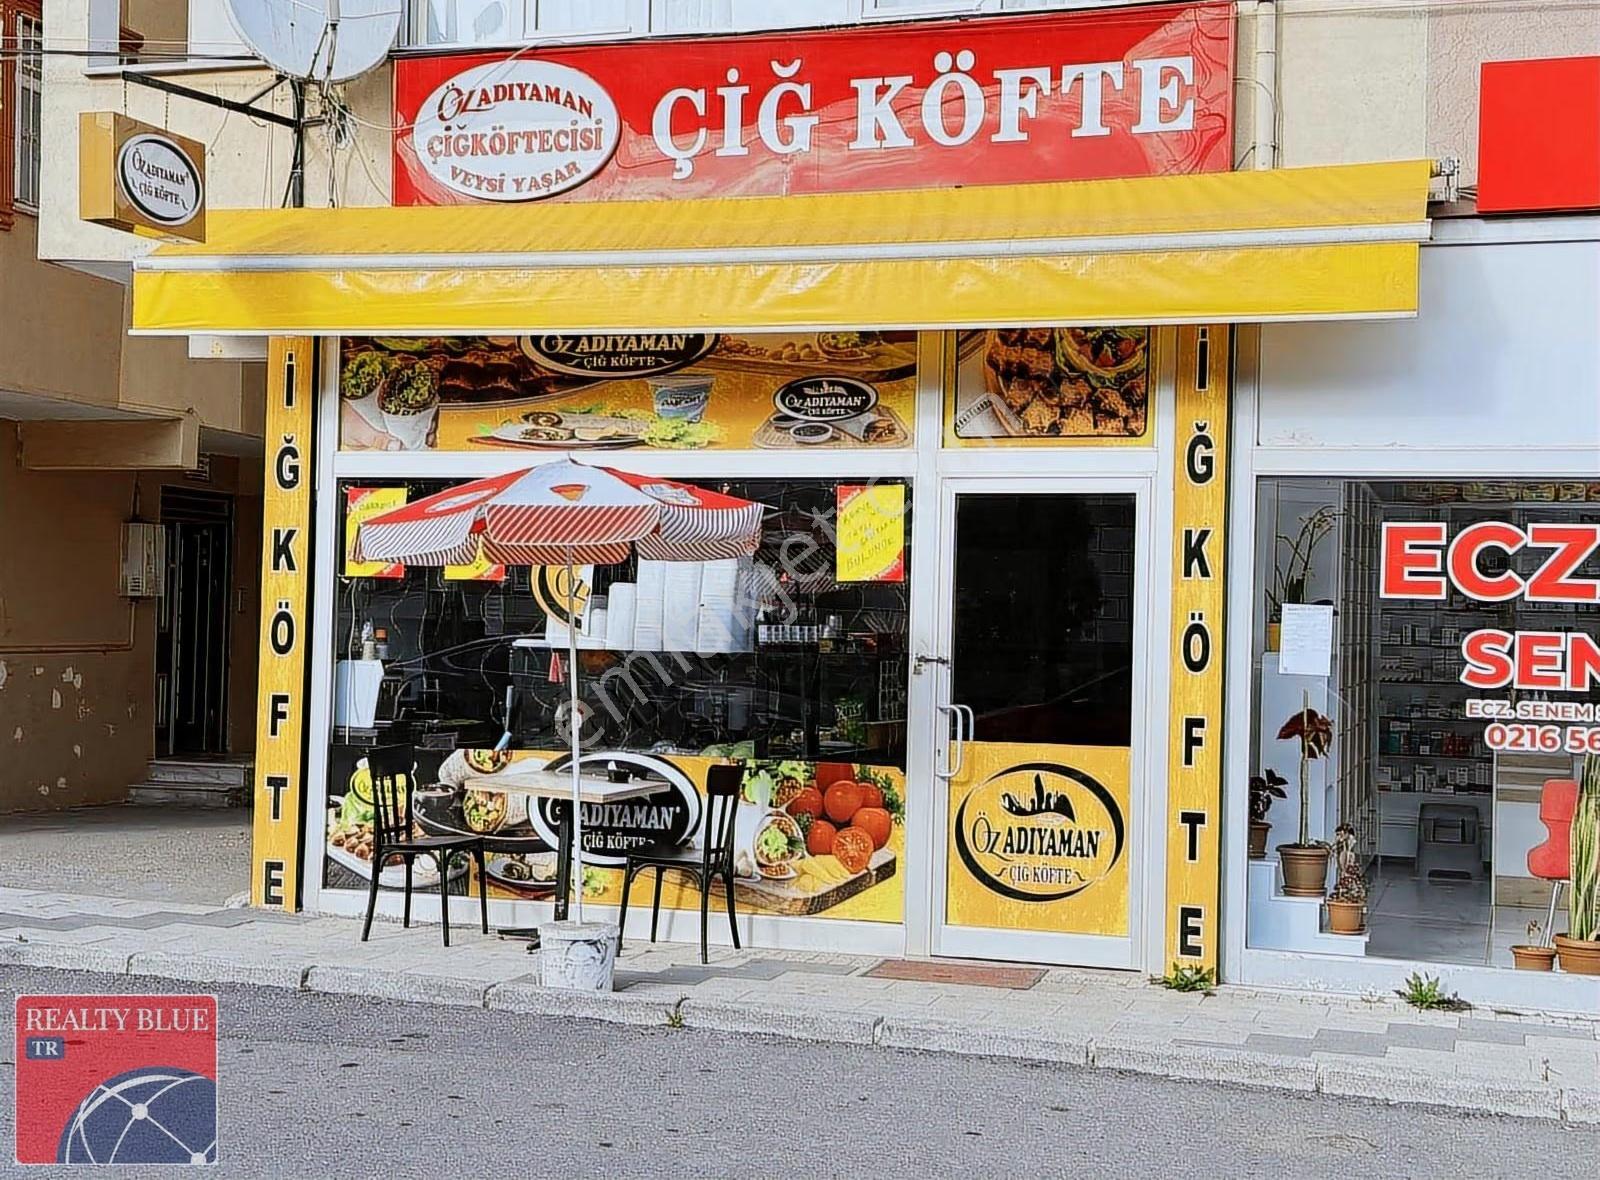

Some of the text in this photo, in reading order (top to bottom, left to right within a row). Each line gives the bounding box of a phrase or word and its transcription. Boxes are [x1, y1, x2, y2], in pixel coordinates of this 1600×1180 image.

[651, 49, 1196, 180] ÇİĞ KÖFTE
[448, 160, 582, 194] VEYSİ YAŞAR
[610, 354, 656, 367] KÖFTE
[1517, 702, 1593, 721] SENEM
[1485, 723, 1562, 752] 0216
[1032, 862, 1073, 885] KÖFTE
